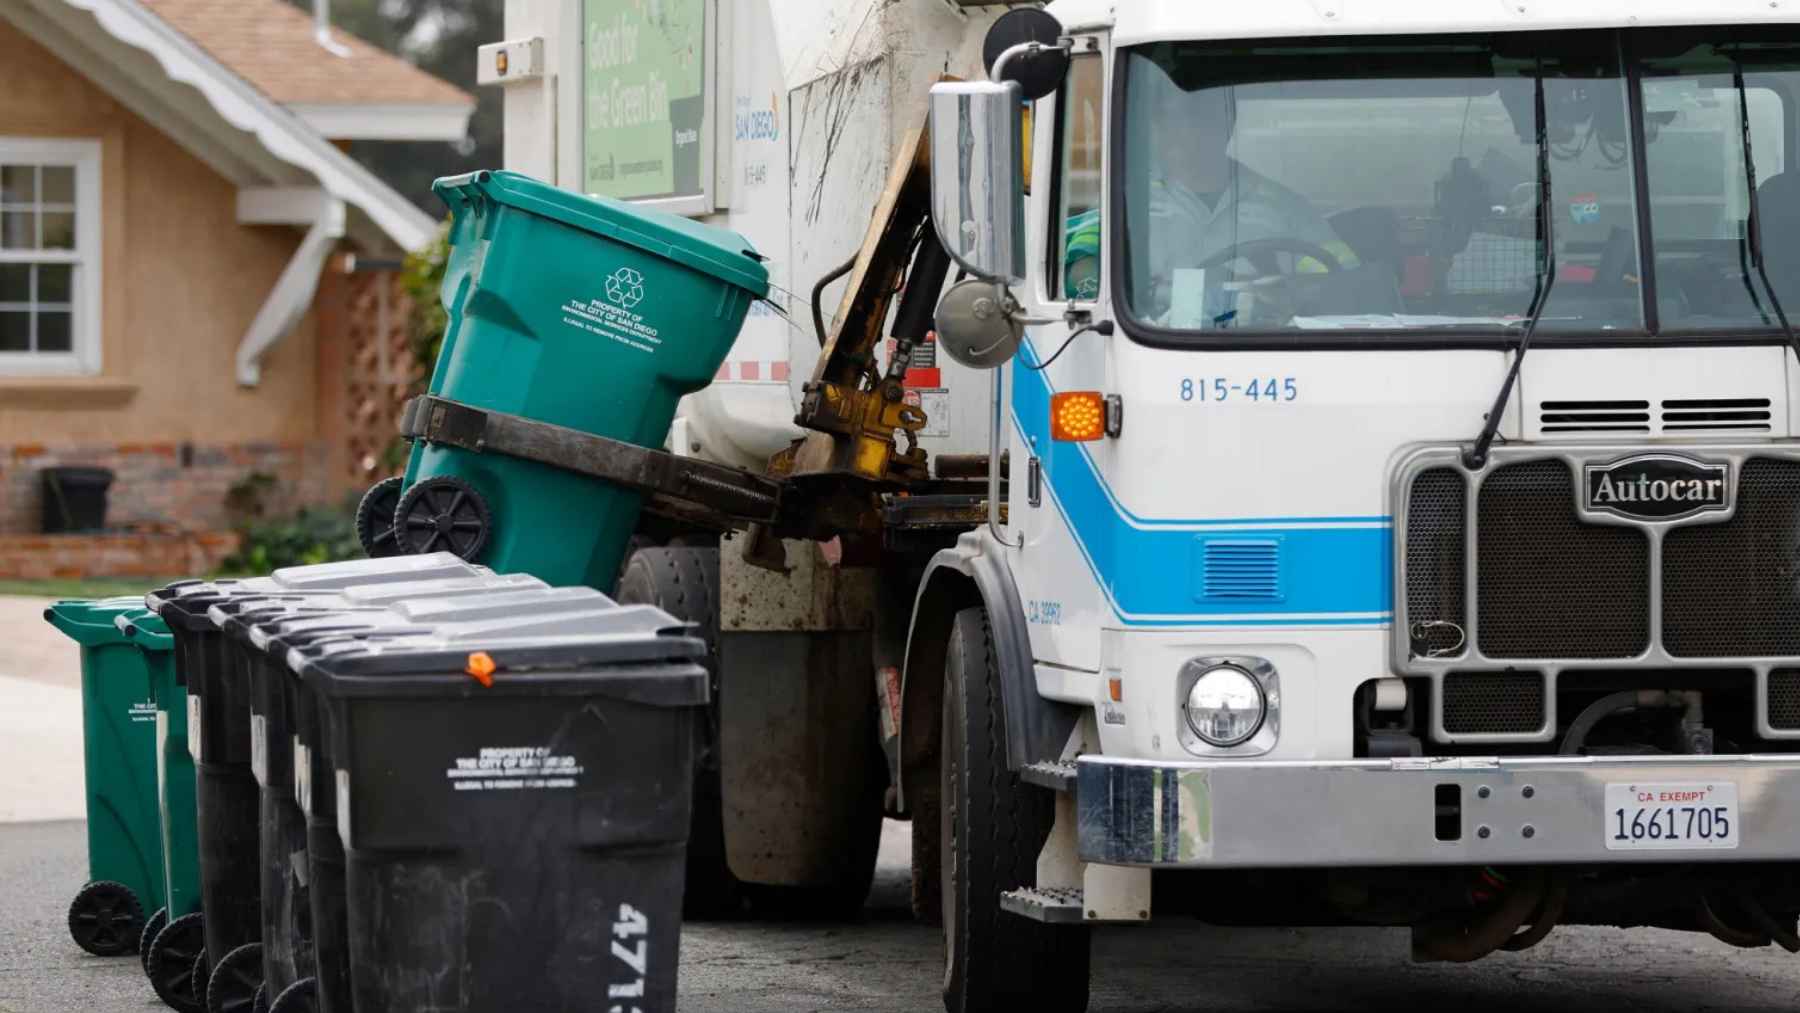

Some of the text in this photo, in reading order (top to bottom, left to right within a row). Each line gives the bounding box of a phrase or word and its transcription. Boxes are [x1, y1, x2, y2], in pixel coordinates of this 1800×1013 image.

[611, 78, 646, 127] Green
[751, 111, 773, 141] DIEGO
[571, 299, 658, 336] THE CITY OF SAN DIEGO
[591, 299, 643, 322] PROPERTY OF
[1181, 378, 1297, 401] 815-445
[1592, 472, 1722, 502] Autocar
[456, 758, 478, 770] THE
[478, 757, 502, 770] CITY
[503, 757, 518, 770] OF
[480, 748, 535, 759] PROPERTY
[1637, 791, 1706, 802] CA EXEMPT
[1614, 807, 1729, 840] 1661705
[607, 903, 648, 1013] 471
